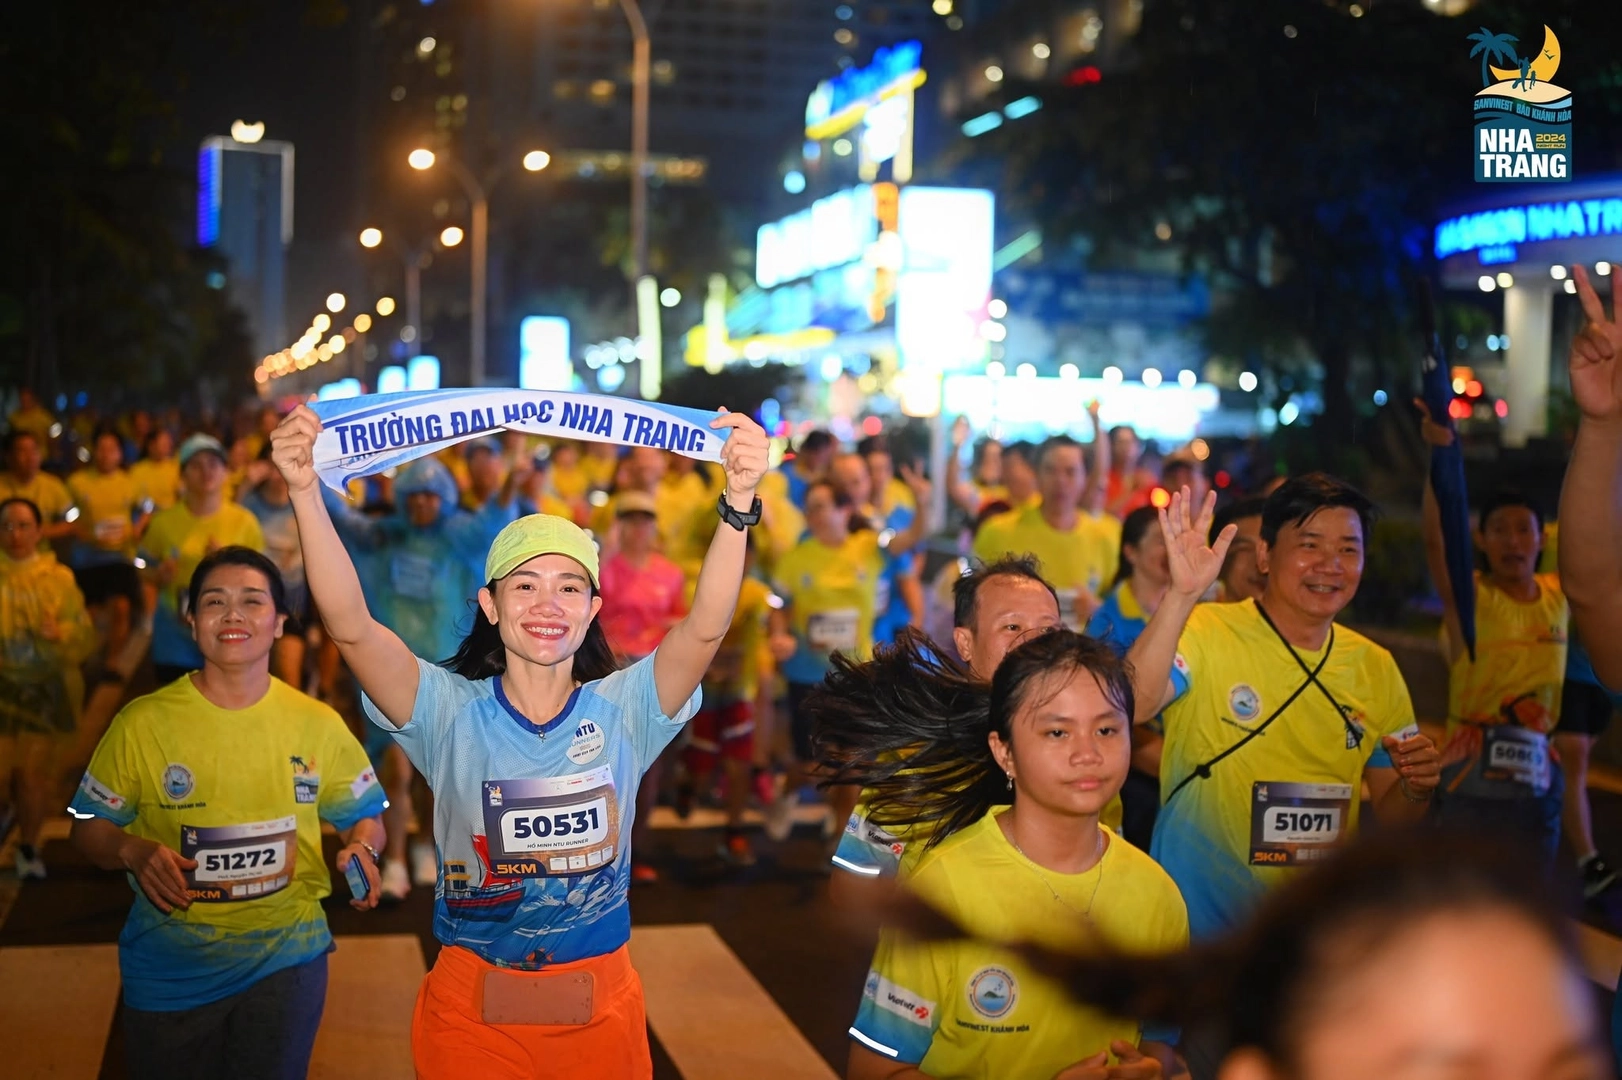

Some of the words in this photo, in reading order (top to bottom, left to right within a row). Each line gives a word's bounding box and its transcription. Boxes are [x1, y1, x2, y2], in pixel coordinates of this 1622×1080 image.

[335, 411, 444, 455] TRƯỜNG
[503, 399, 554, 425] HỌC
[559, 401, 613, 438] NHA
[622, 412, 705, 452] TRANG
[575, 722, 596, 738] NTU
[514, 807, 599, 839] 50531
[1274, 812, 1332, 832] 51071
[566, 838, 589, 846] RUNNER
[205, 848, 276, 872] 51272
[1254, 851, 1287, 862] 5KM
[496, 863, 537, 874] 5KM
[187, 890, 220, 899] 5KM
